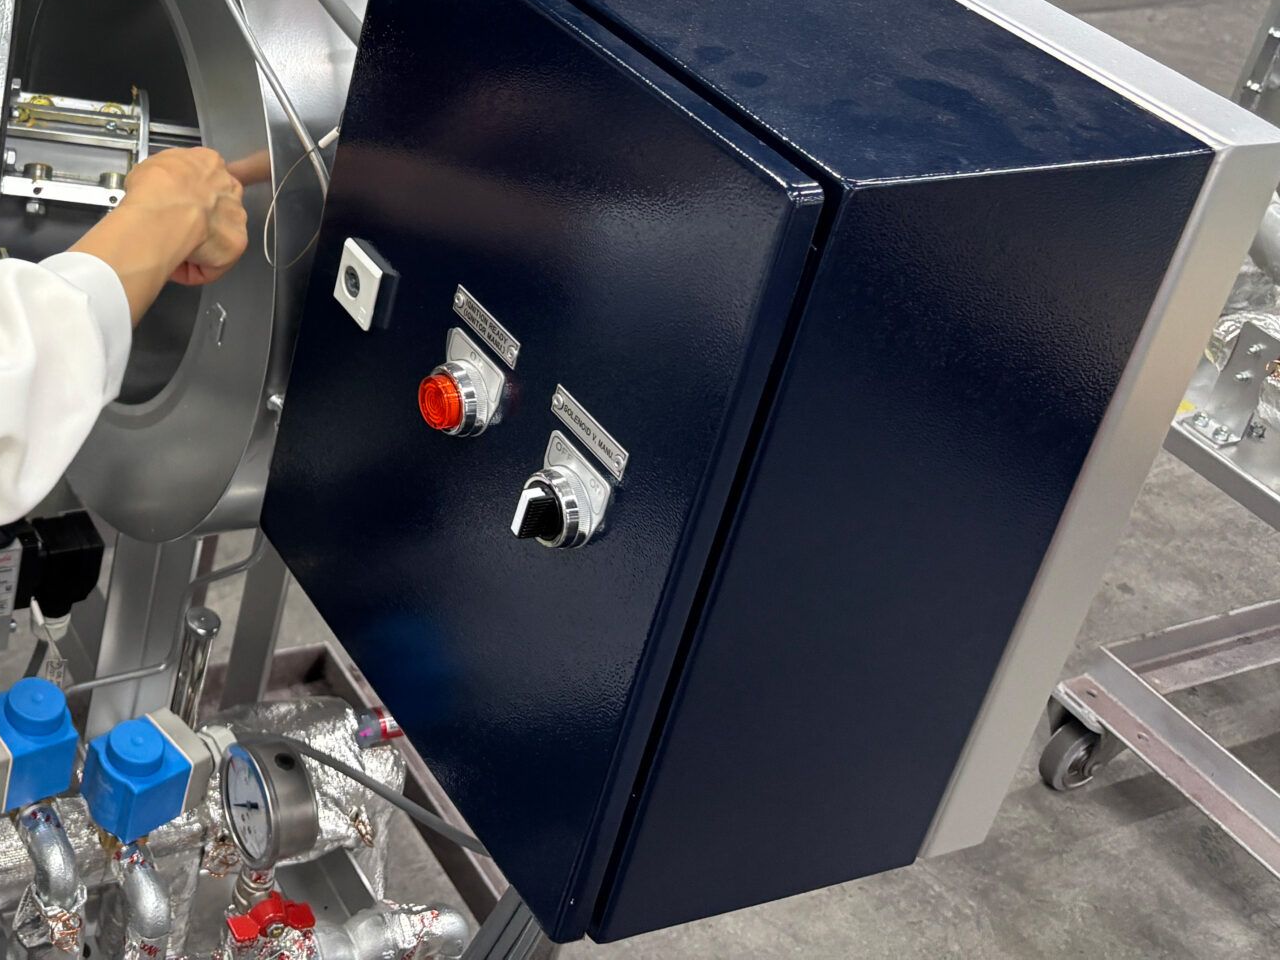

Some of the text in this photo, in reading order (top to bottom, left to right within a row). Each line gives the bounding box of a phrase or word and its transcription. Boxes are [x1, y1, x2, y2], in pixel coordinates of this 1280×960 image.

[466, 298, 508, 344] IGNITION READY
[563, 404, 592, 436] SOLENOID
